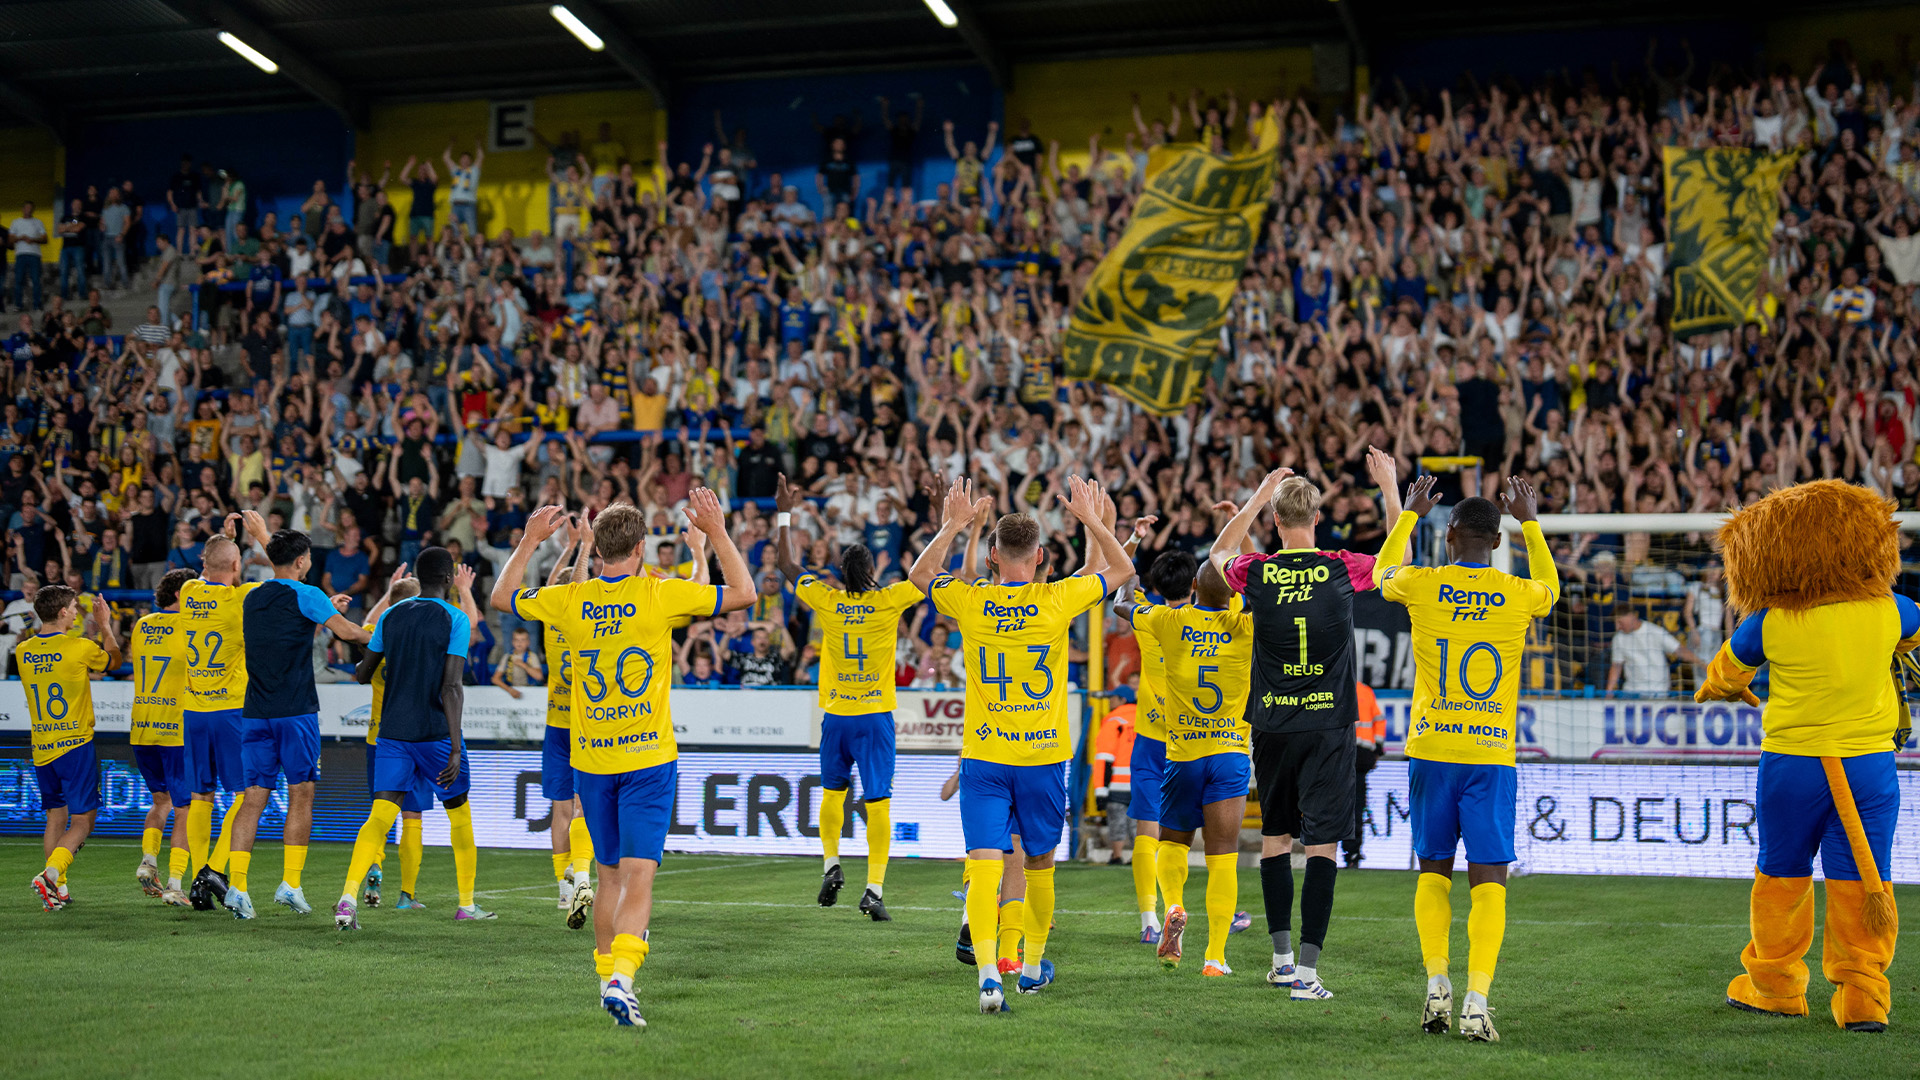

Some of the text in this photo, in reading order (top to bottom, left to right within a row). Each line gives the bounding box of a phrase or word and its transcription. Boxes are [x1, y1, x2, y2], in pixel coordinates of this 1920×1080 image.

[497, 105, 526, 147] E
[1262, 563, 1330, 584] Remo
[1276, 584, 1313, 605] Frit
[1438, 584, 1506, 607] Remo
[186, 596, 217, 610] Remo
[582, 601, 636, 620] Remo
[836, 603, 875, 614] Remo
[983, 600, 1038, 618] Remo
[192, 610, 209, 620] Frit
[844, 616, 866, 626] Frit
[1452, 606, 1488, 622] Frit
[140, 622, 174, 635] Remo
[593, 620, 622, 638] Frit
[996, 618, 1026, 634] Frit
[144, 636, 163, 646] Frit
[1180, 626, 1232, 644] Remo
[1294, 617, 1308, 666] 1
[186, 630, 225, 668] 32
[844, 632, 868, 671] 4
[1190, 644, 1219, 658] Frit
[23, 652, 62, 664] Remo
[34, 663, 54, 674] Frit
[140, 656, 172, 694] 17
[579, 646, 654, 702] 30
[979, 645, 1054, 701] 43
[1284, 664, 1324, 676] REUS
[1436, 638, 1502, 700] 10
[838, 673, 880, 682] BATEAU
[1192, 665, 1223, 714] 5
[30, 682, 68, 720] 18
[988, 701, 1050, 712] COOPMAN
[1274, 696, 1298, 706] VAN
[1306, 702, 1334, 712] Logistics
[1430, 698, 1502, 714] LIMBOMBE
[586, 701, 652, 720] CORRYN
[32, 720, 79, 732] DEWAELE
[152, 722, 178, 730] MOER
[1178, 714, 1236, 728] EVERTON
[1604, 705, 1762, 746] LUCTOR
[996, 728, 1058, 742] VAN MOER
[1183, 730, 1244, 742] VAN MOER
[1434, 722, 1508, 740] VAN MOER
[37, 742, 54, 751] VAN
[57, 738, 85, 749] MOER
[591, 731, 658, 748] VAN MOER
[1032, 742, 1059, 750] Logistics
[1476, 738, 1508, 750] Logistics
[626, 743, 660, 753] Logistics
